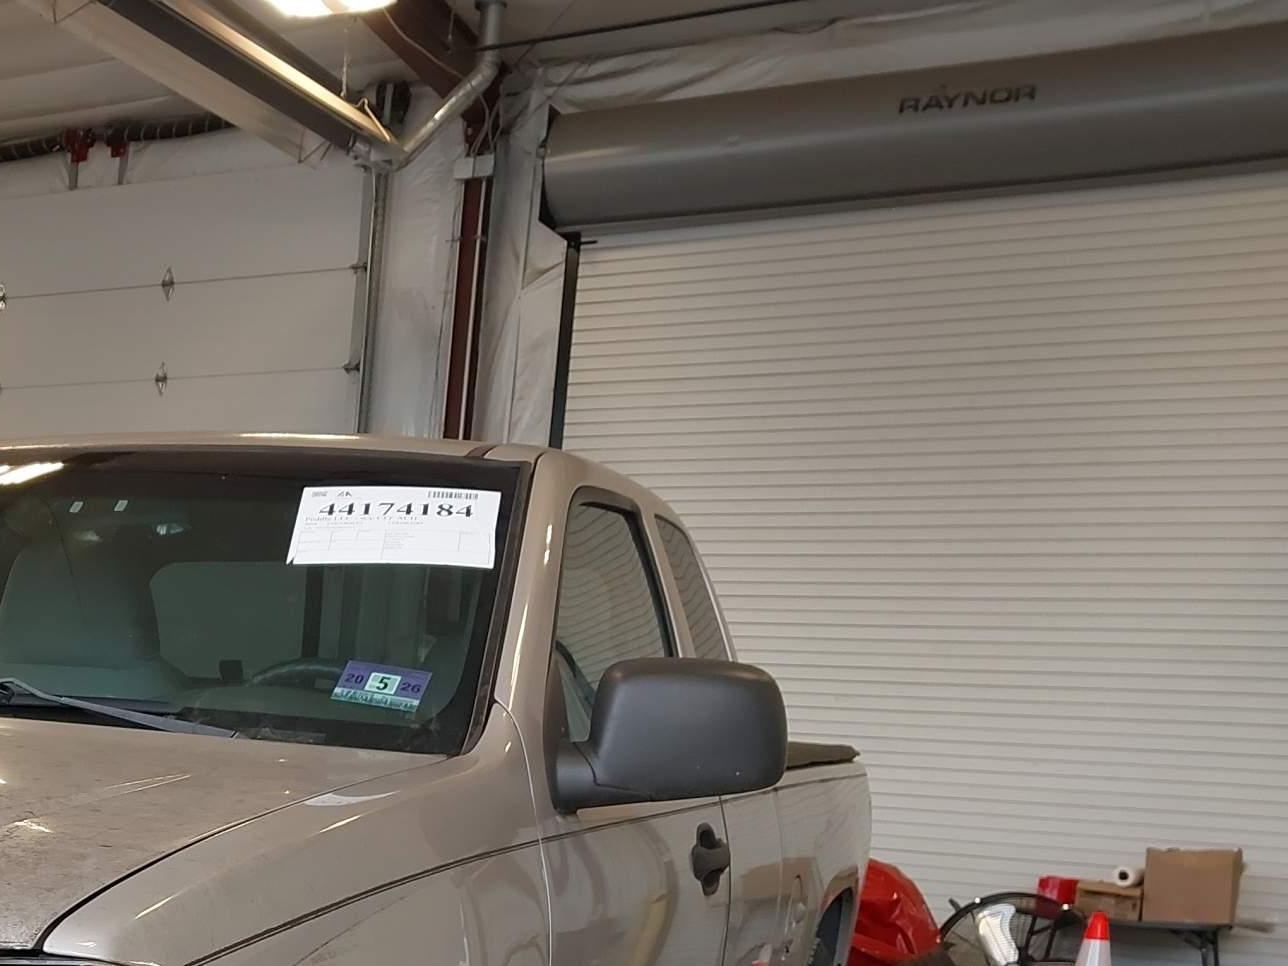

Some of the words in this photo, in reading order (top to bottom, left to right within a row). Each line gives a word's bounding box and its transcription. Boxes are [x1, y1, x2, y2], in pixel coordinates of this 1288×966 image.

[898, 84, 1037, 114] RAYNOR
[319, 502, 473, 518] 44174184
[345, 673, 365, 684] 20
[376, 676, 391, 691] 5
[400, 682, 422, 694] 26
